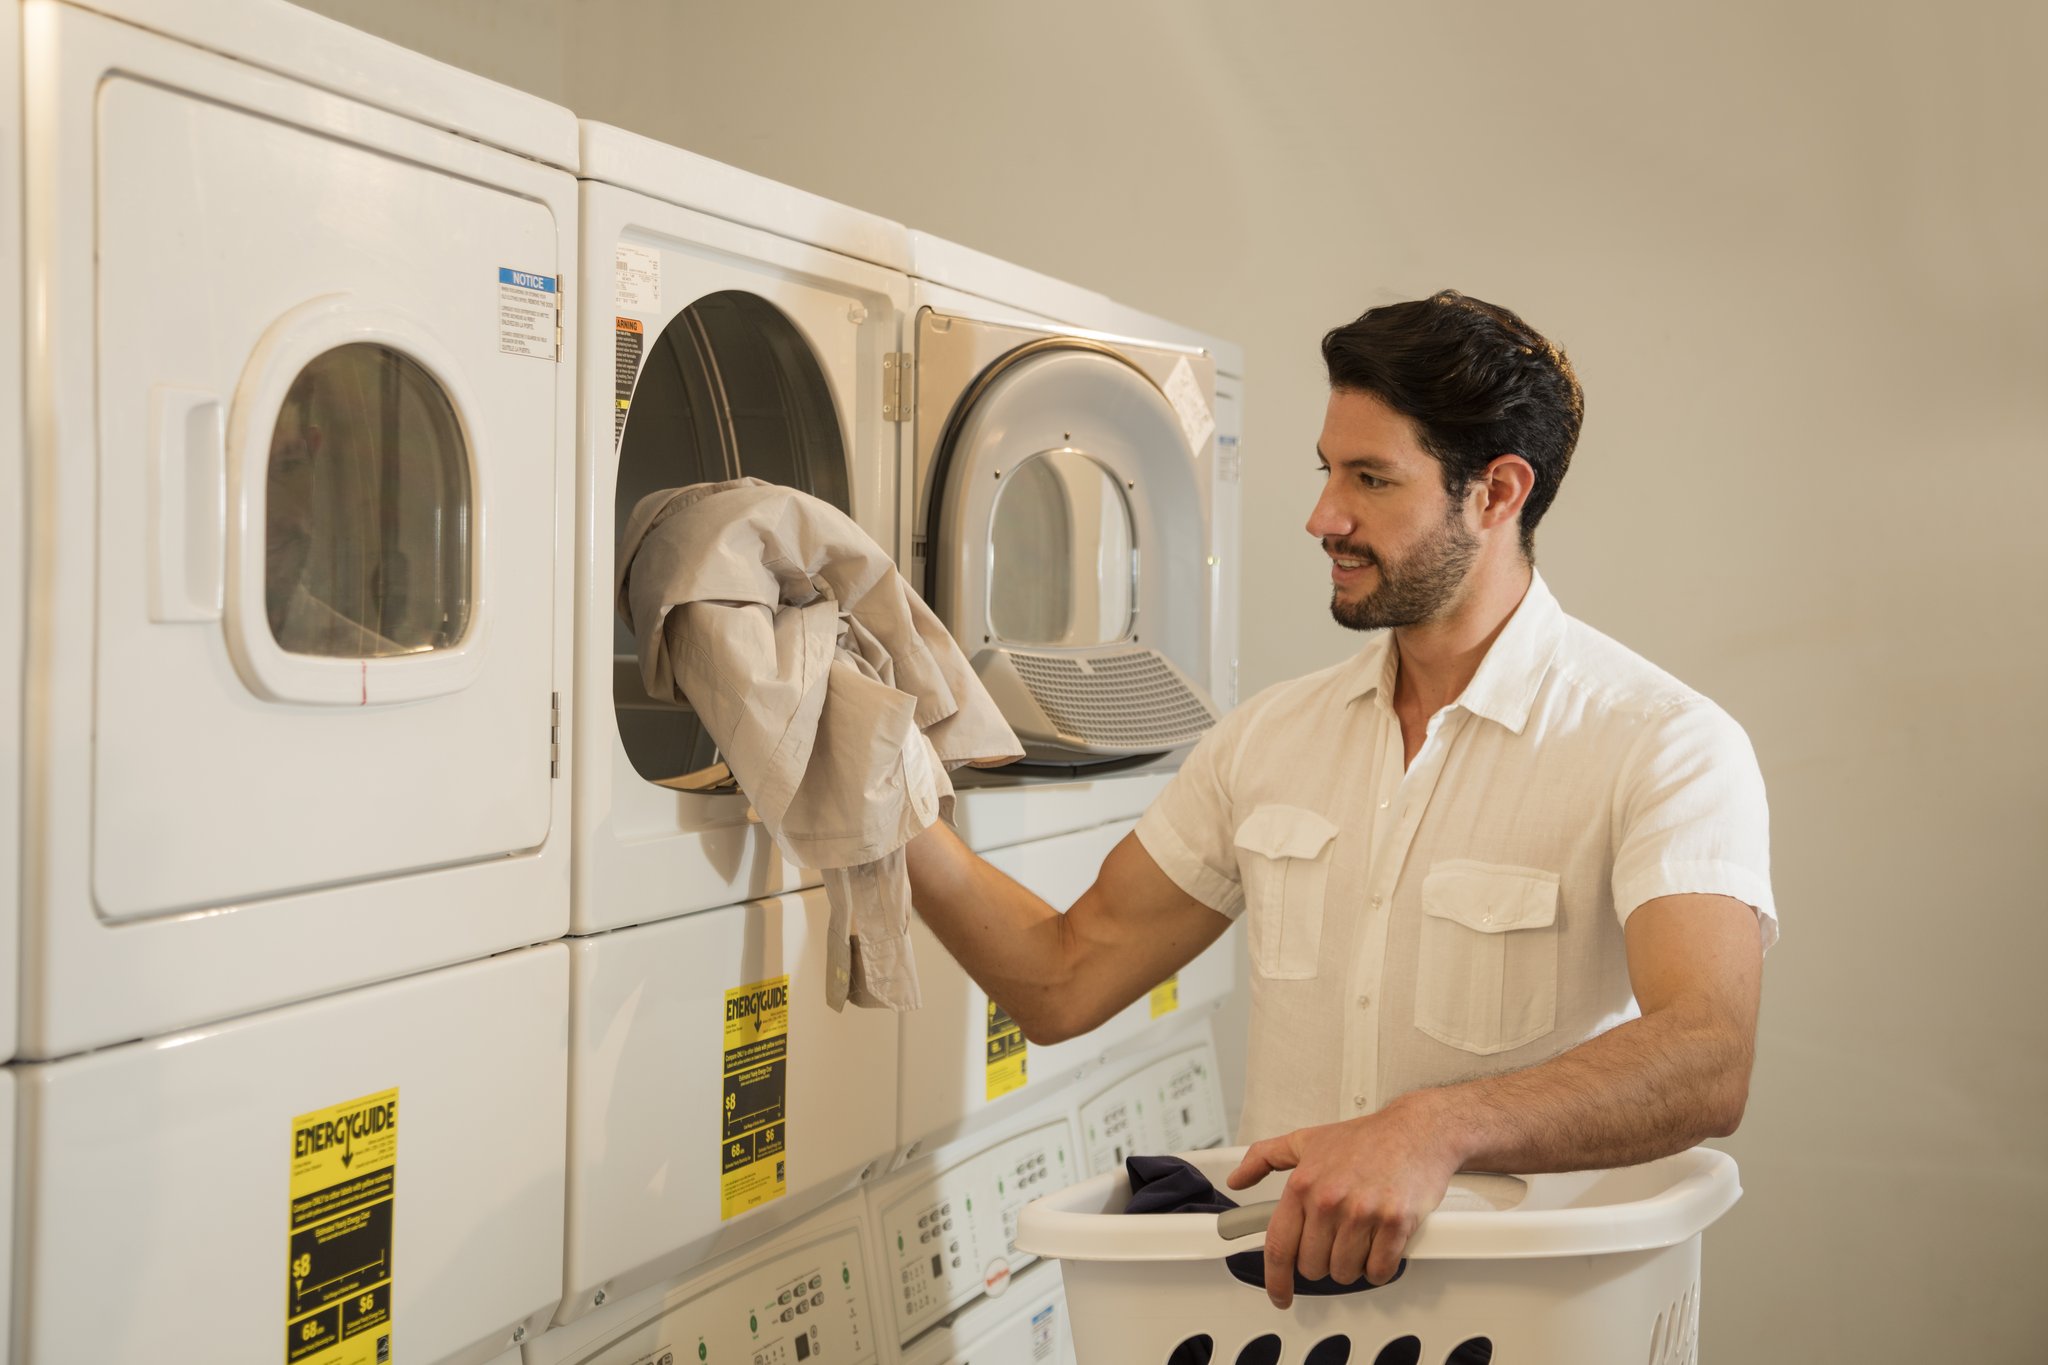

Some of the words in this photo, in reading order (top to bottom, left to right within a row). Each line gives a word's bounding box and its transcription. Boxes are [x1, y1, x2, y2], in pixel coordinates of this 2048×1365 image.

[513, 272, 544, 289] NOTICE
[616, 319, 638, 331] ARNING
[727, 985, 788, 1022] ENERGYGUIDE
[725, 1093, 736, 1110] $8
[295, 1101, 395, 1159] ENERGYGUIDE
[766, 1129, 774, 1142] $6
[293, 1253, 311, 1278] $8
[359, 1293, 374, 1314] $6
[302, 1321, 317, 1340] 68
